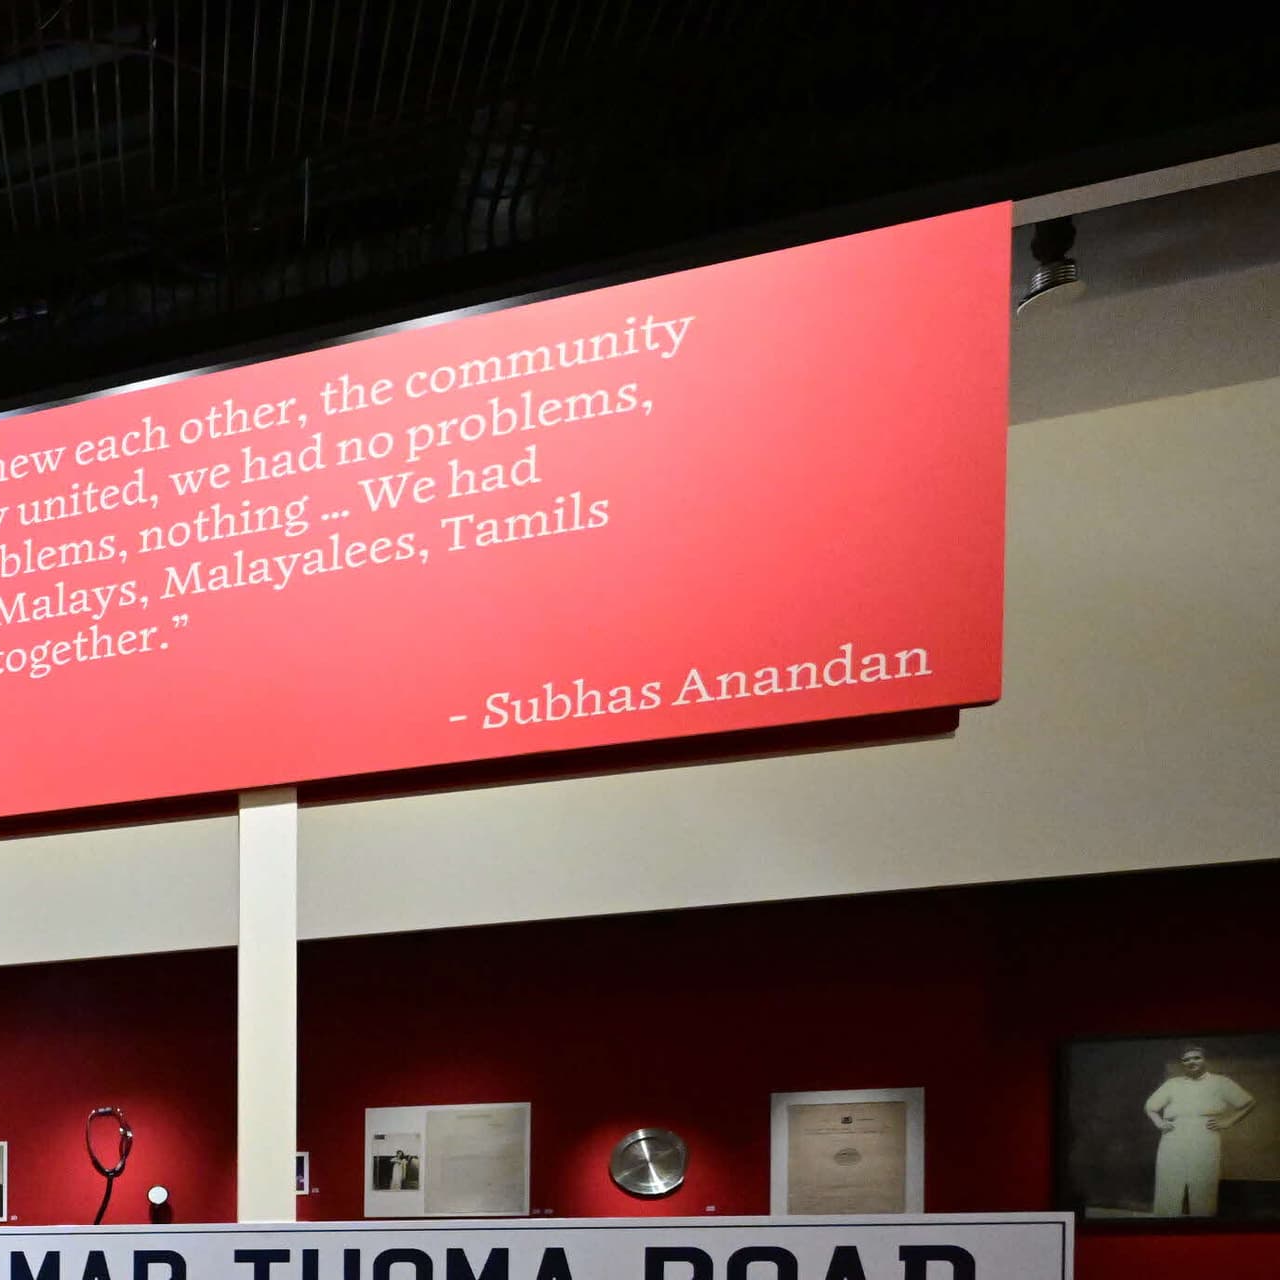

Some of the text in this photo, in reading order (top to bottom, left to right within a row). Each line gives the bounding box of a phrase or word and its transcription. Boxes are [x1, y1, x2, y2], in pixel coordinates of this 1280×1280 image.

[75, 416, 170, 465] each
[180, 398, 307, 444] other,
[317, 373, 393, 419] the
[405, 315, 694, 398] community
[18, 471, 158, 525] united,
[169, 464, 230, 495] we
[241, 437, 327, 483] had
[336, 432, 394, 465] no
[406, 383, 652, 463] problems,
[139, 495, 309, 552] nothing
[357, 471, 436, 512] We
[448, 446, 542, 498] had
[160, 533, 428, 599] Malayalees,
[440, 496, 608, 551] Tamils
[482, 678, 661, 729] Subhas
[672, 645, 931, 705] Anandan
